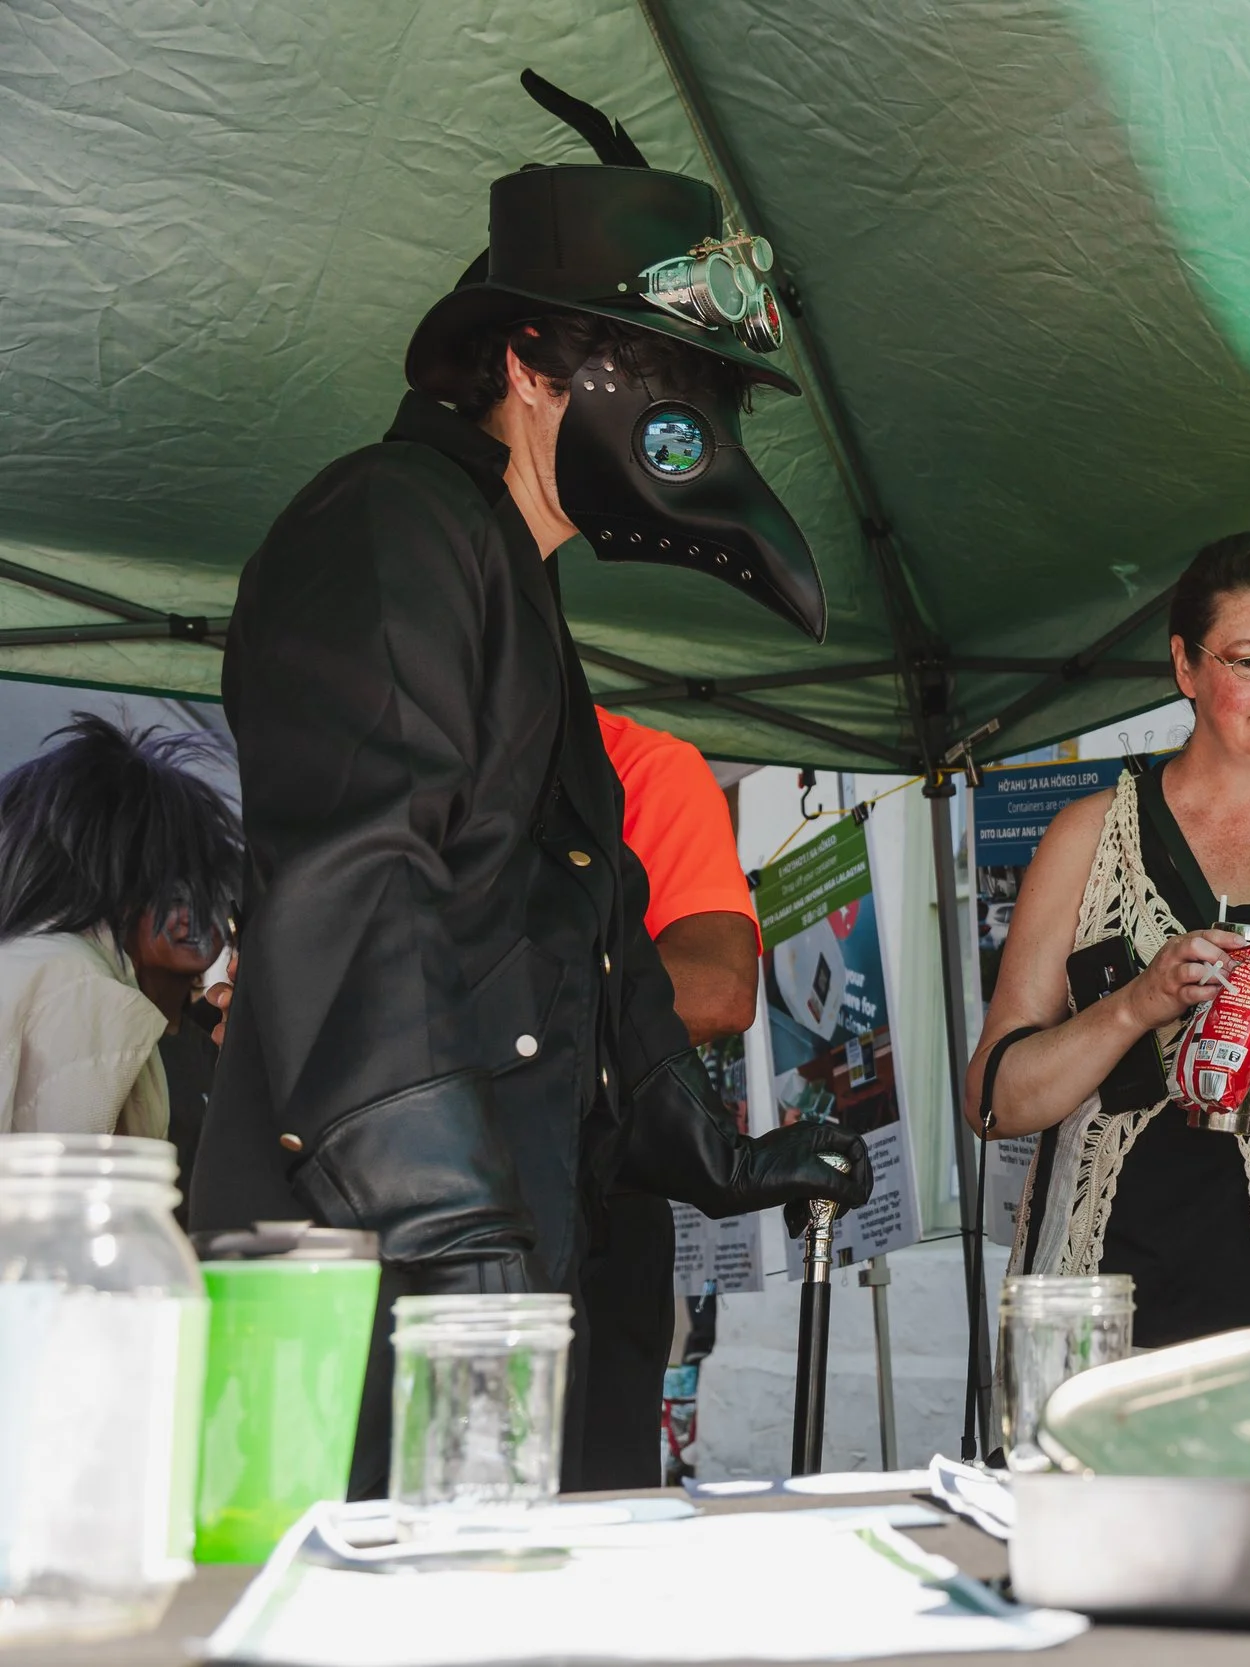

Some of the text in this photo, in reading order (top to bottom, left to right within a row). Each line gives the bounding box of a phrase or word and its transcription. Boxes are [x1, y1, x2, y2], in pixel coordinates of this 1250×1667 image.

[980, 828, 995, 839] DITO
[996, 827, 1020, 838] ILAGAY
[1021, 826, 1036, 836] ANG
